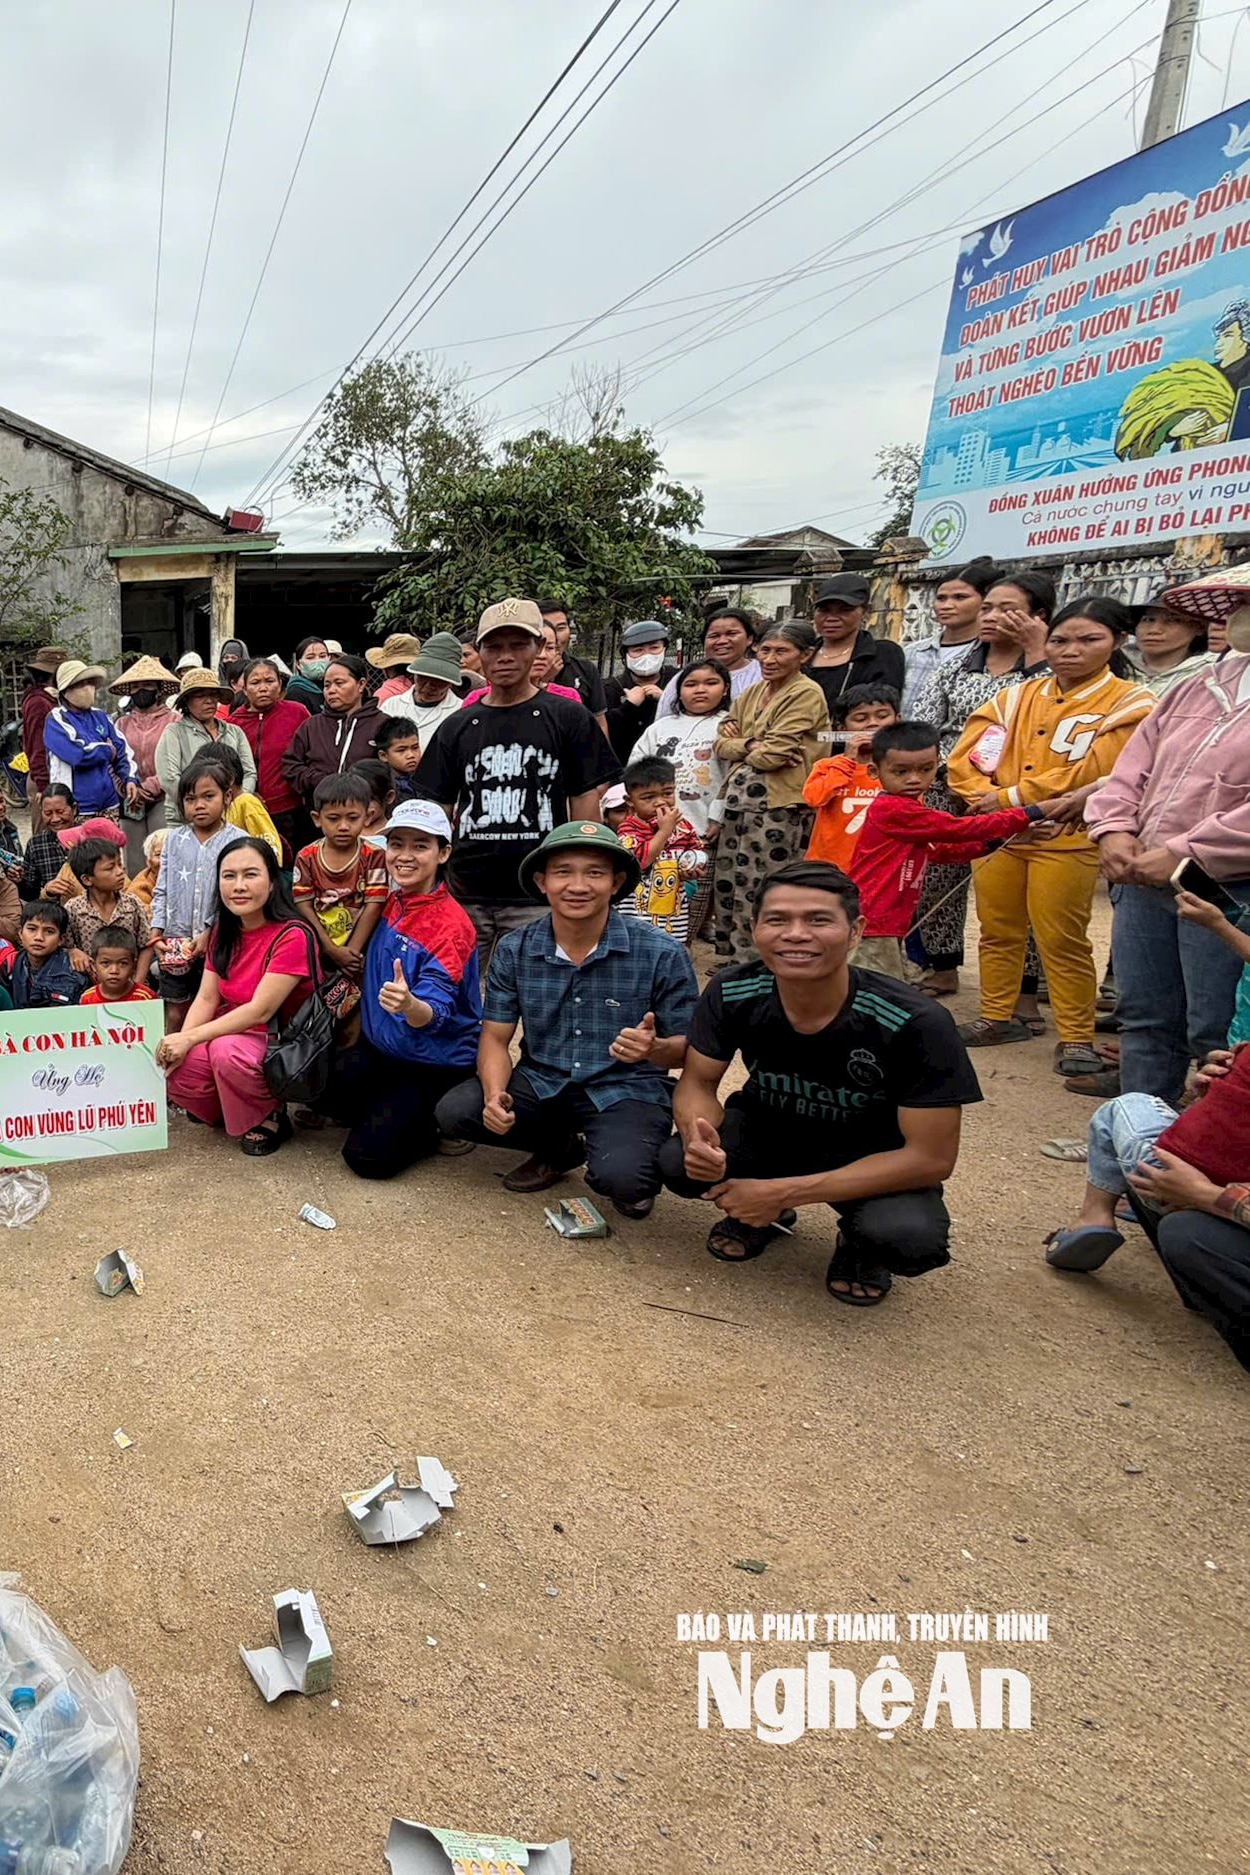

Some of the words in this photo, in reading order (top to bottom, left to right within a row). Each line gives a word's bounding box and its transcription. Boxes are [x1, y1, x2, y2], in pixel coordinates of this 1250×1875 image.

[966, 272, 1009, 310] PHÁT
[1010, 257, 1048, 292] HUY
[1051, 243, 1080, 276] VAI
[1085, 221, 1122, 262] TRÒ
[1127, 200, 1189, 246] CỘNG
[1193, 173, 1250, 220] ĐỒN
[959, 312, 1004, 346] ĐOÀN
[1006, 294, 1041, 330] KẾT
[1043, 280, 1087, 317] GIÚP
[1091, 257, 1149, 300] NHAU
[1154, 232, 1216, 278] GIẢM
[954, 353, 973, 383] VÀ
[978, 342, 1020, 375] TỪNG
[1023, 323, 1073, 361] BƯỚC
[1078, 303, 1133, 344] VƯƠN
[1136, 287, 1181, 326] LÊN
[948, 384, 997, 418] THOÁT
[997, 366, 1058, 404] NGHÈO
[1060, 350, 1102, 387] BỀN
[1106, 336, 1163, 375] VỮNG
[1031, 484, 1075, 508] XUÂN
[1078, 473, 1139, 499] HƯỞNG
[1142, 466, 1184, 489] ỨNG
[1187, 454, 1250, 481] PHON
[1092, 498, 1148, 516] chung
[1154, 491, 1184, 508] tay
[1026, 525, 1081, 548] KHÔNG
[1084, 515, 1111, 541] ĐỂ
[1110, 519, 1130, 537] AI
[1134, 516, 1155, 537] BỊ
[1157, 506, 1185, 531] BỎ
[1189, 506, 1223, 529] LẠI
[1049, 713, 1105, 762] G
[22, 1032, 65, 1053] CON
[71, 1025, 102, 1048] HÀ
[107, 1022, 145, 1050] NỘI
[74, 1063, 106, 1088] Hộ
[4, 1115, 35, 1140] CON
[38, 1107, 75, 1136] VÙNG
[77, 1103, 95, 1131] LŨ
[98, 1100, 125, 1128] PHÚ
[128, 1098, 157, 1125] YÊN
[759, 1089, 789, 1110] FLY
